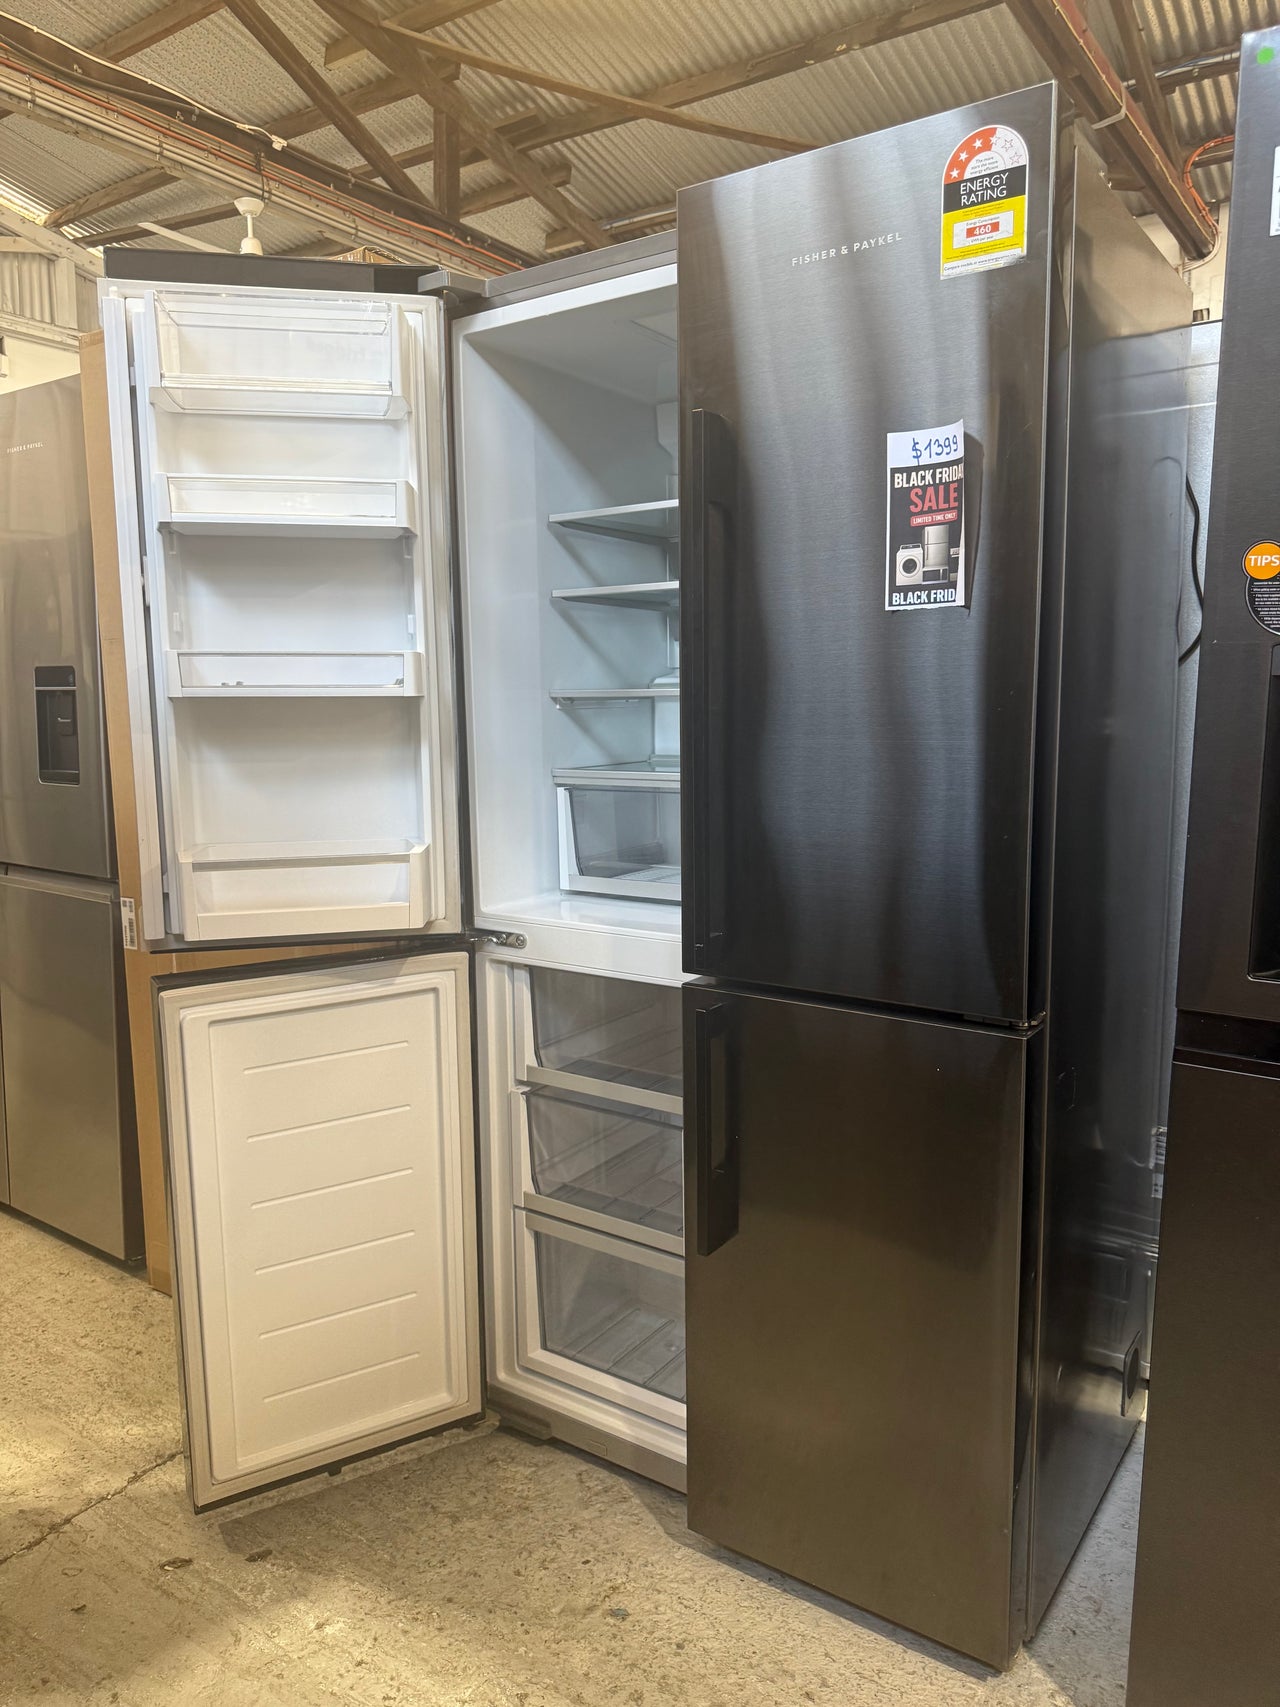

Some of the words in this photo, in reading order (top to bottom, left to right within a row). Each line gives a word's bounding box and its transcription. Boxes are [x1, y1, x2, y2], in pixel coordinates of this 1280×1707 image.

[961, 172, 1009, 194] ENERGY
[961, 186, 1007, 206] RATING
[973, 225, 991, 235] 460
[791, 249, 836, 267] FISHER
[840, 245, 849, 255] &
[853, 232, 902, 252] PAYKEL
[911, 434, 959, 466] $1399
[894, 469, 933, 488] BLACK
[909, 482, 959, 513] SALE
[913, 515, 932, 524] LIMITED
[933, 513, 945, 521] TIME
[945, 512, 956, 520] ONLY
[1248, 554, 1280, 567] TIPS
[892, 590, 928, 605] BLACK
